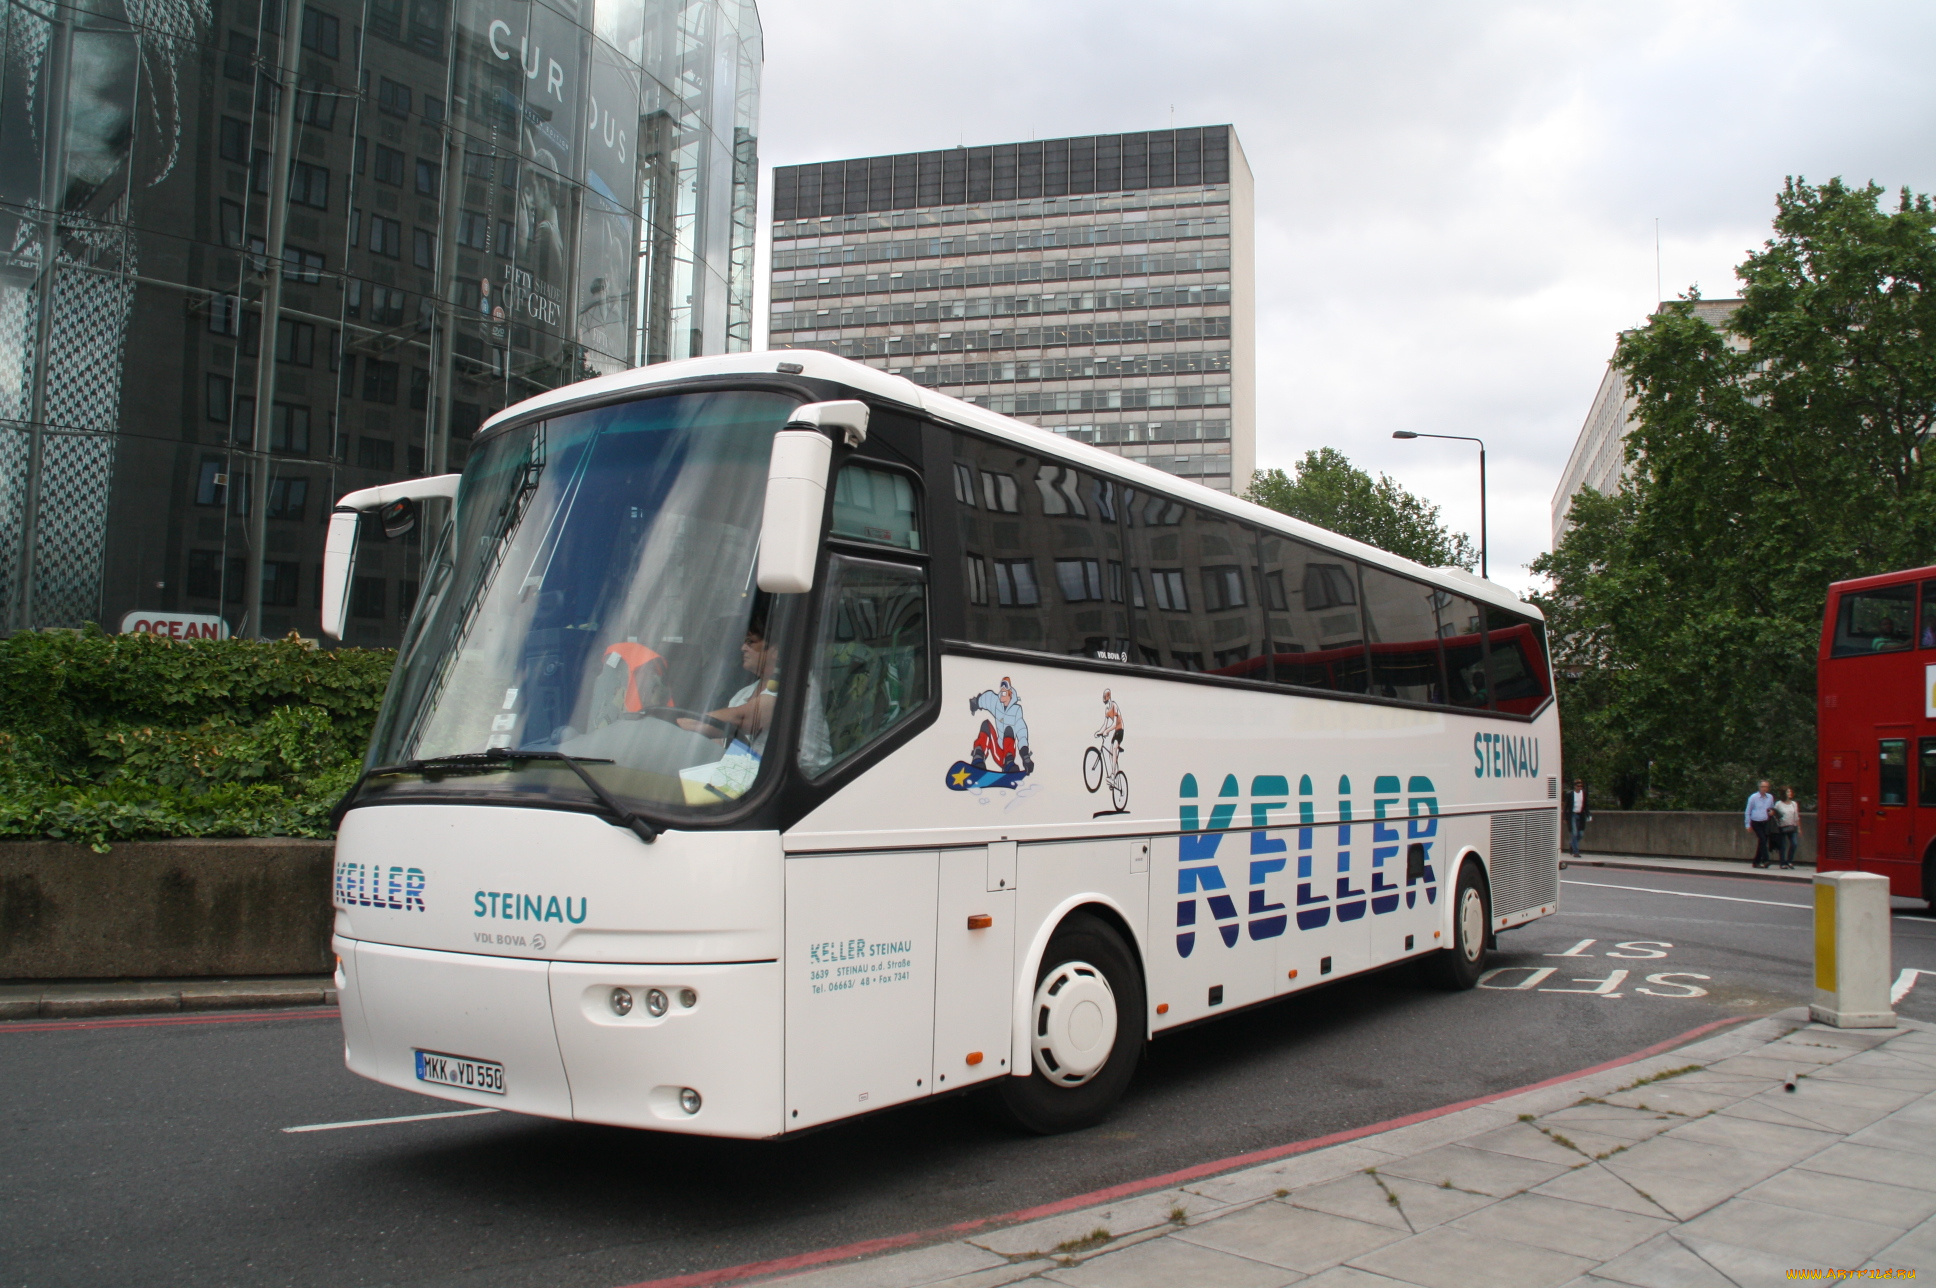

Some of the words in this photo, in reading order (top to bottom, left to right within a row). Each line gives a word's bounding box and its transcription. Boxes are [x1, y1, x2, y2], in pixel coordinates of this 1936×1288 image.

[545, 126, 569, 150] EDITION
[134, 619, 219, 641] OCEAN
[1474, 731, 1539, 779] STEINAU
[1176, 772, 1439, 958] KELLER
[335, 861, 426, 912] KELLER
[474, 890, 587, 924] STEINAU
[473, 931, 494, 944] VDL
[496, 934, 527, 947] BOVA
[810, 938, 866, 964] KELLER
[869, 940, 912, 957] STEINAU
[810, 969, 829, 980] 3639
[836, 964, 869, 977] STEINAU
[812, 984, 826, 994] Tel.
[860, 977, 870, 986] 48
[878, 975, 892, 984] Fax
[893, 971, 910, 982] 7341
[424, 1056, 448, 1081] MKK
[457, 1061, 475, 1086] YD
[477, 1065, 503, 1091] 550
